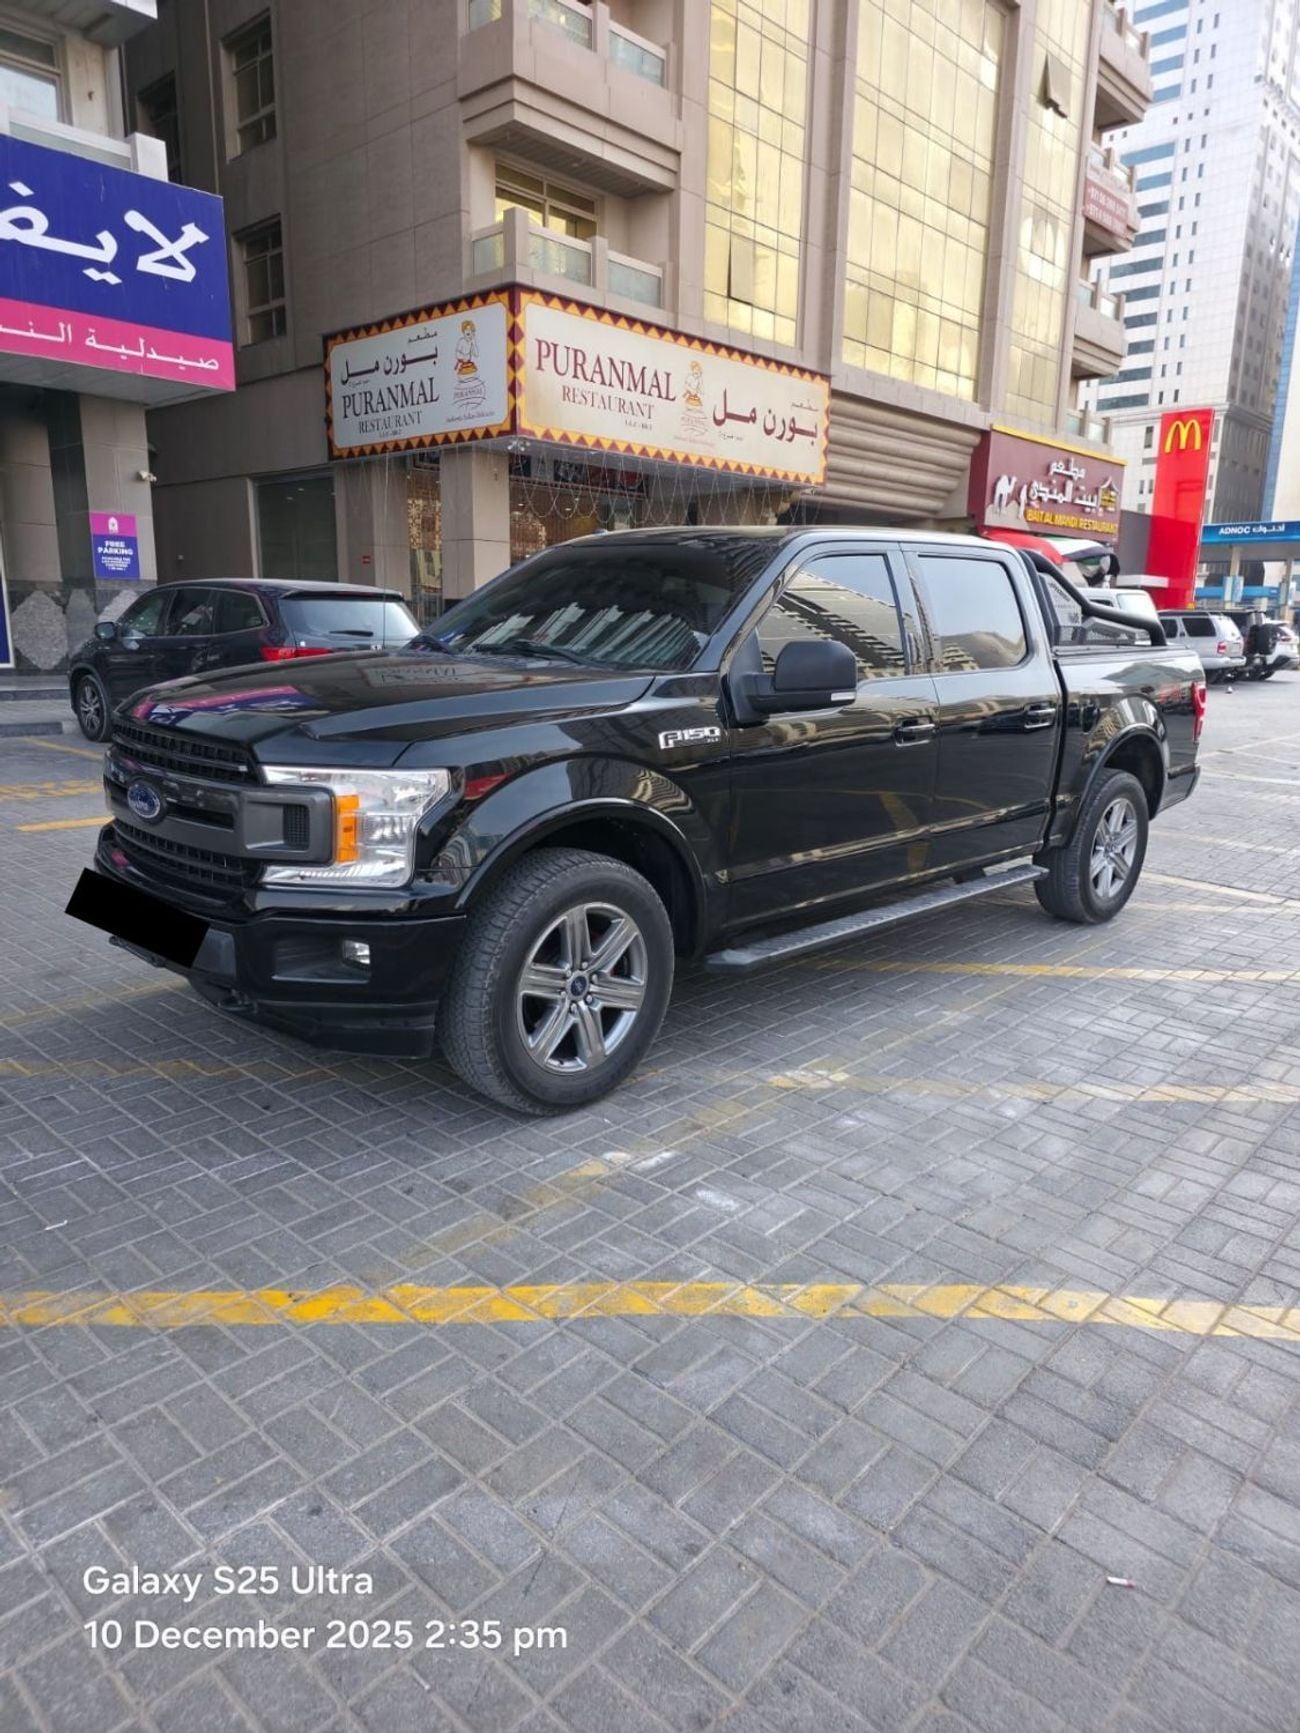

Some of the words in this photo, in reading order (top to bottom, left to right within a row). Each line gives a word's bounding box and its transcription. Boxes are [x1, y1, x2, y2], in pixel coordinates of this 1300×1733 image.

[0, 321, 72, 345] الن
[85, 327, 220, 371] صيدلية
[383, 346, 438, 376] بورن
[340, 357, 379, 385] مل
[535, 339, 676, 401] PURANMAL
[342, 377, 439, 419] PURANMAL
[562, 384, 656, 420] RESTAURANT
[713, 387, 757, 427] مل
[358, 410, 424, 435] RESTAURANT
[763, 408, 818, 446] بورن
[1048, 458, 1086, 480] مطعم
[1026, 509, 1044, 523] BAIT
[1044, 513, 1055, 524] AL
[1219, 526, 1250, 535] ADNOC
[97, 546, 133, 555] PARKING
[104, 540, 125, 548] FREE
